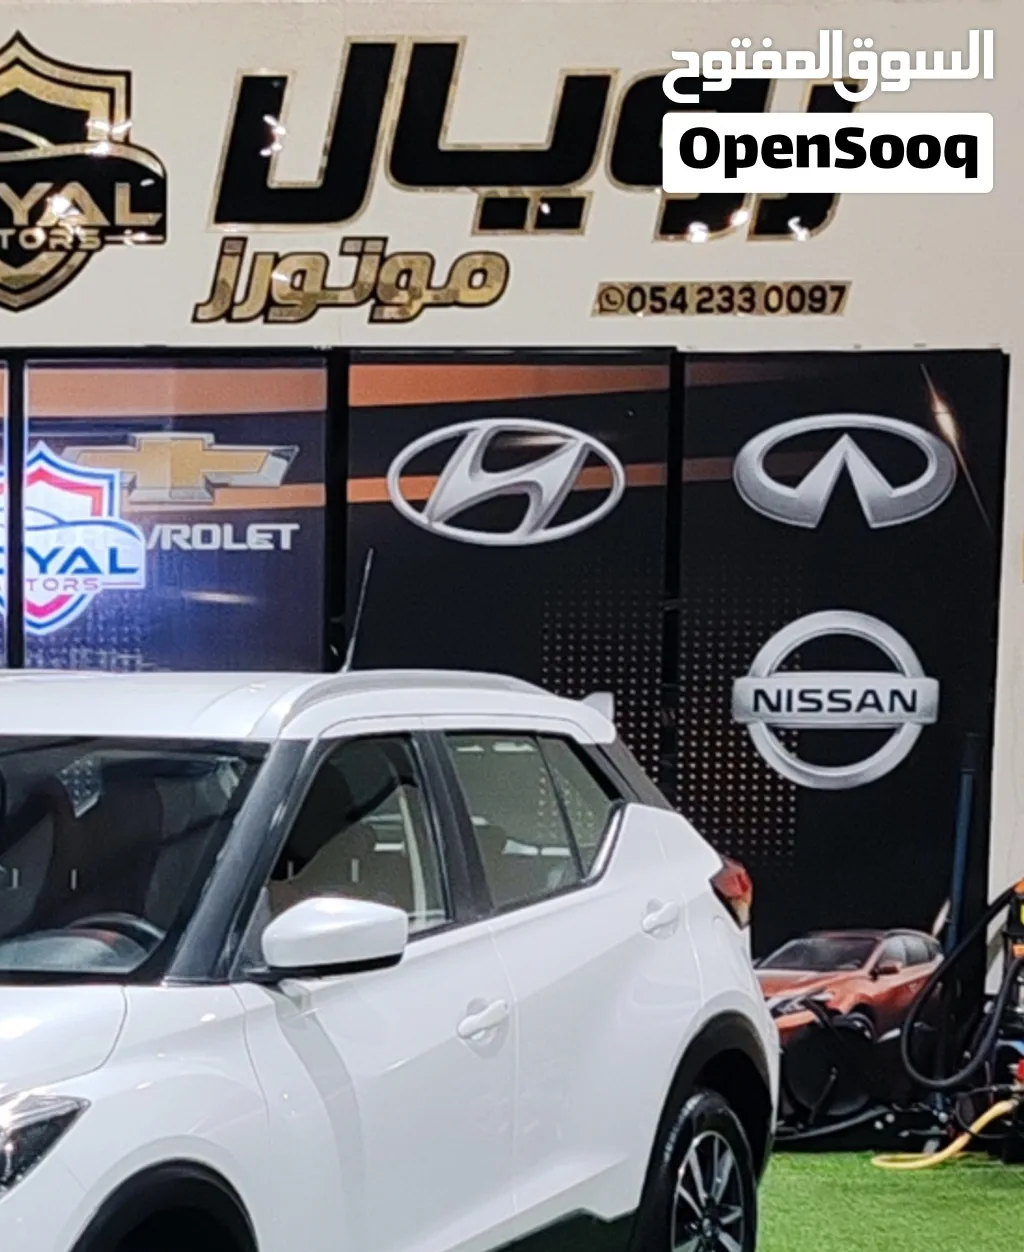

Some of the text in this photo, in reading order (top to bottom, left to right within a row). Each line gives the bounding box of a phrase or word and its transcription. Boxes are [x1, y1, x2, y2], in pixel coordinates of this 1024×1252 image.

[192, 234, 510, 323] موتورز
[627, 284, 847, 314] 054 233 0097
[146, 523, 300, 551] VROLET
[752, 689, 918, 714] NISSAN
